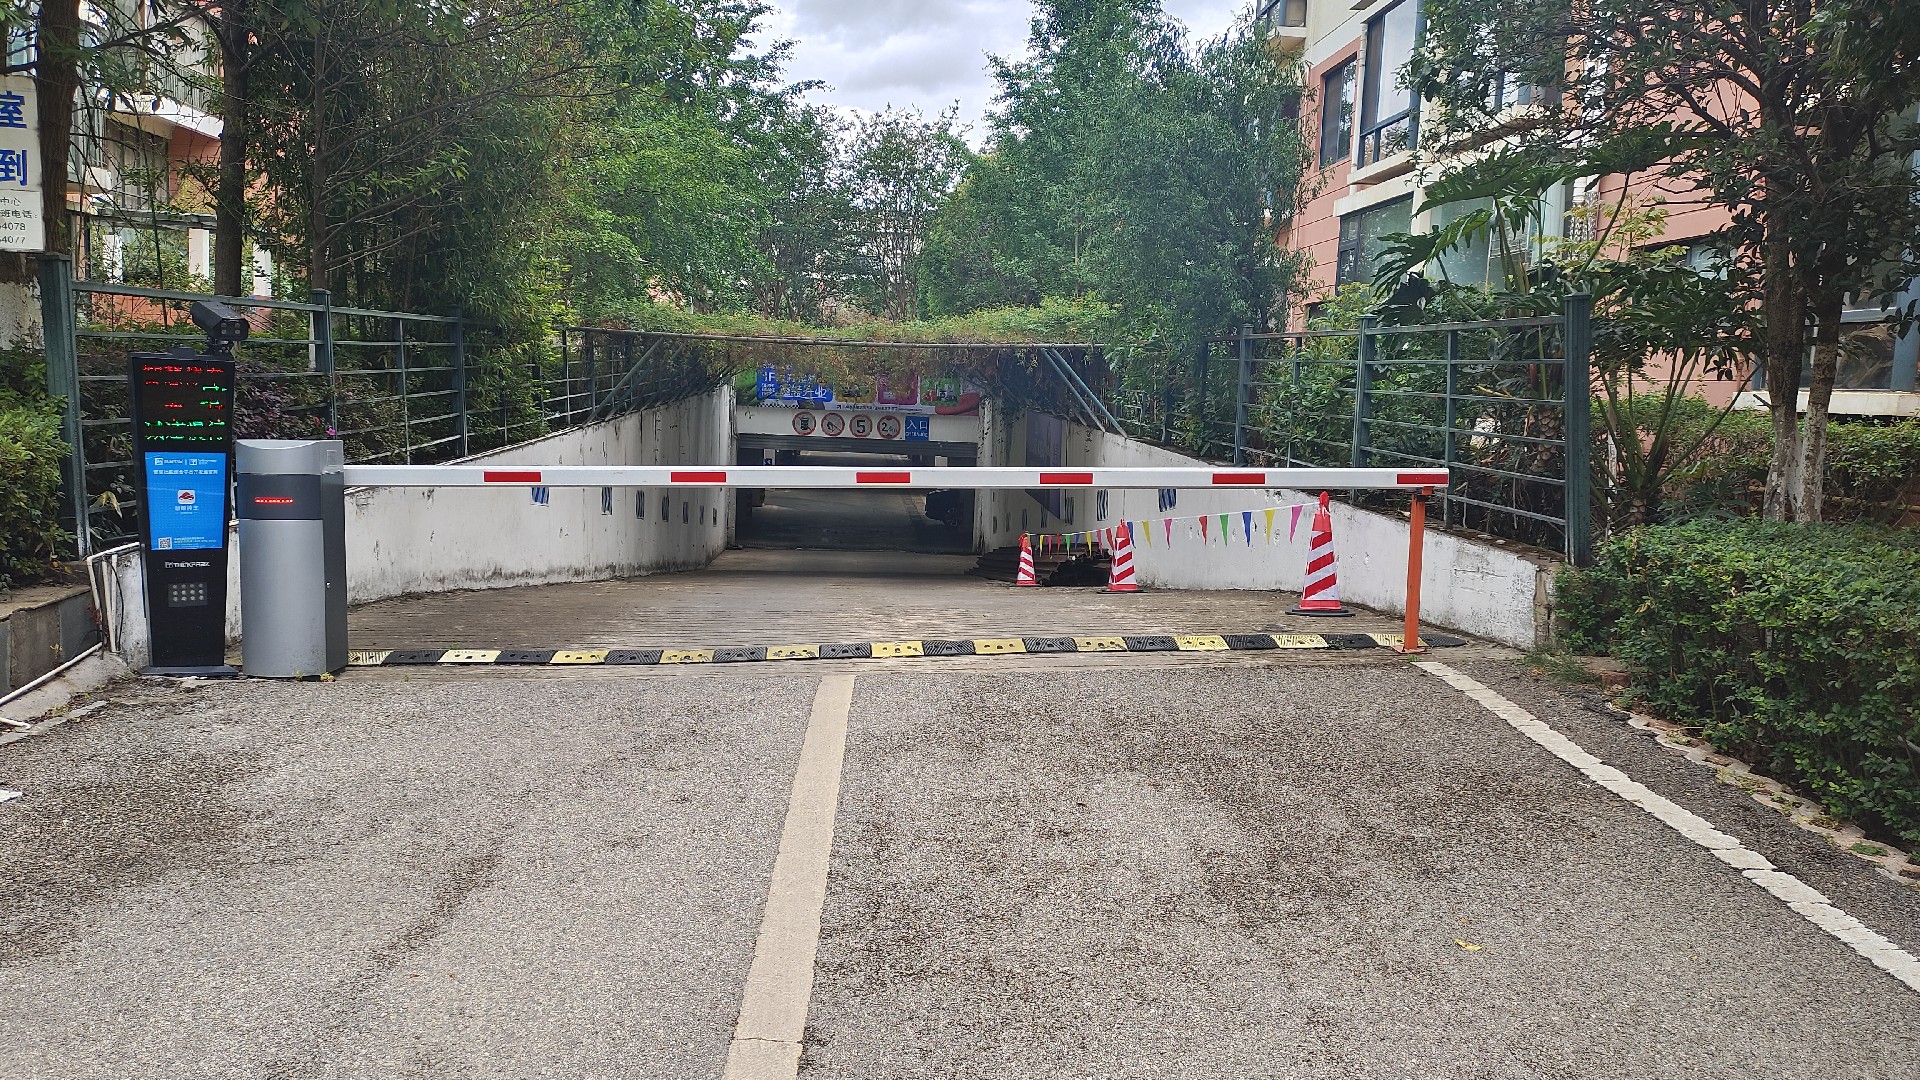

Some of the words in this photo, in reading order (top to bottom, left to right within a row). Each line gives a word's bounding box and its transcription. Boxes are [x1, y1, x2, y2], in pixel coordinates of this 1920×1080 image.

[0, 222, 26, 231] 4078
[0, 235, 26, 244] 4077
[856, 419, 866, 434] 5
[906, 419, 928, 430] 入口
